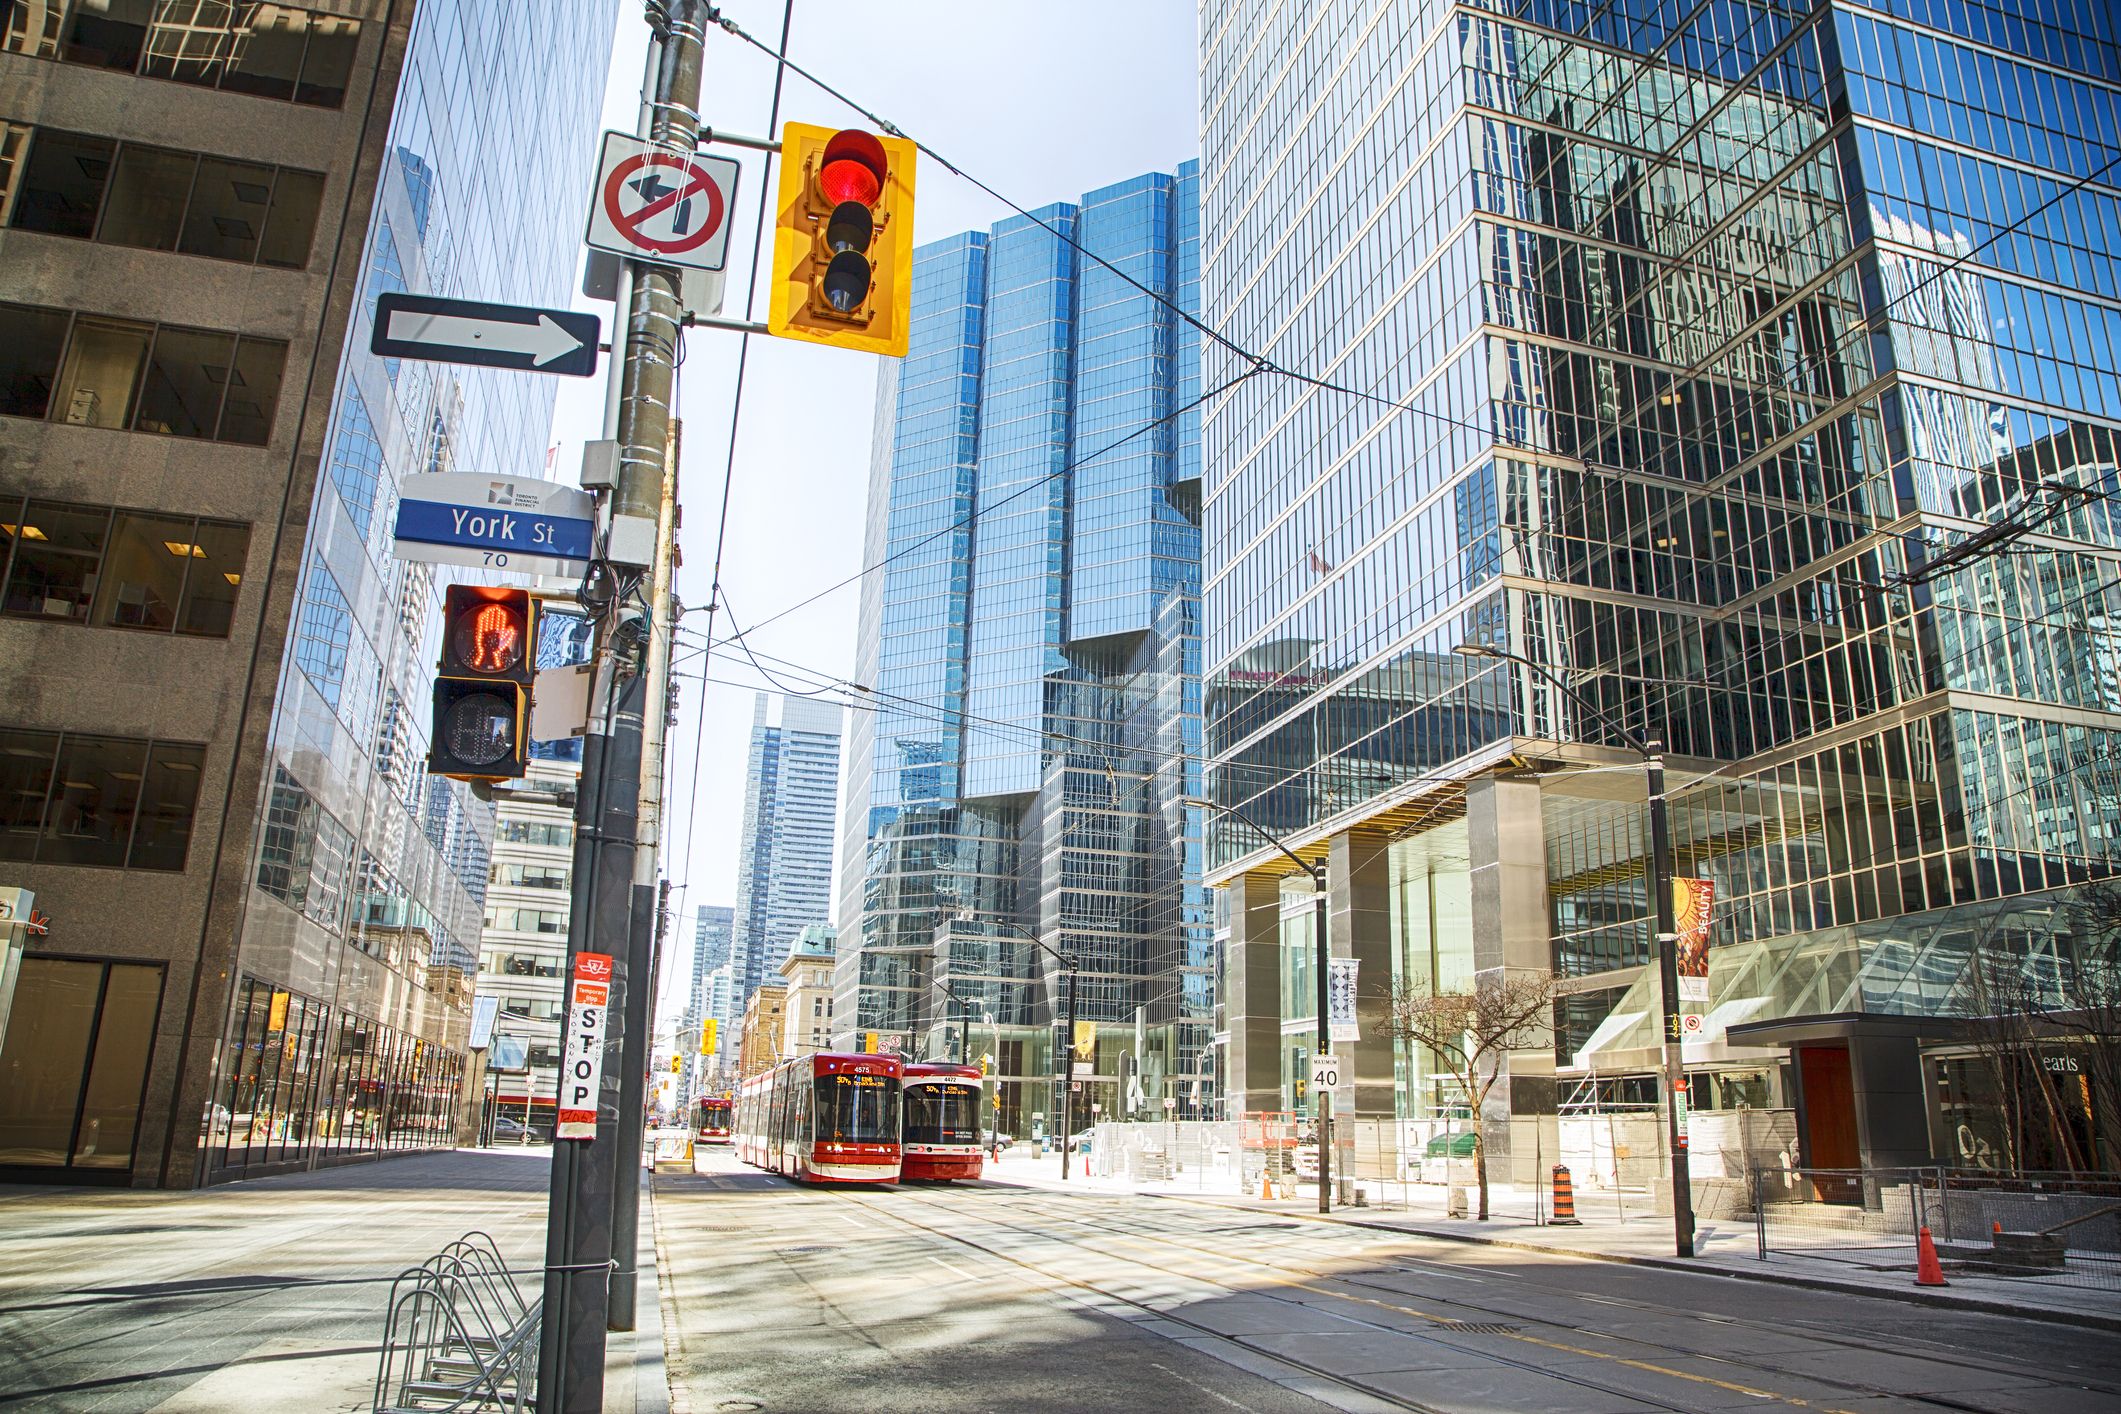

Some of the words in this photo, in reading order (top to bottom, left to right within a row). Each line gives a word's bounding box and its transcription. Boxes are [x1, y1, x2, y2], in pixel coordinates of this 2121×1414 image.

[452, 508, 516, 540] York
[532, 522, 555, 544] St
[483, 551, 508, 567] 70
[1698, 885, 1712, 934] BEAUTY
[578, 987, 606, 998] Temporary
[585, 994, 598, 1003] Stop
[573, 1008, 597, 1105] STOP
[2043, 1055, 2079, 1072] earls
[1314, 1070, 1337, 1086] 40
